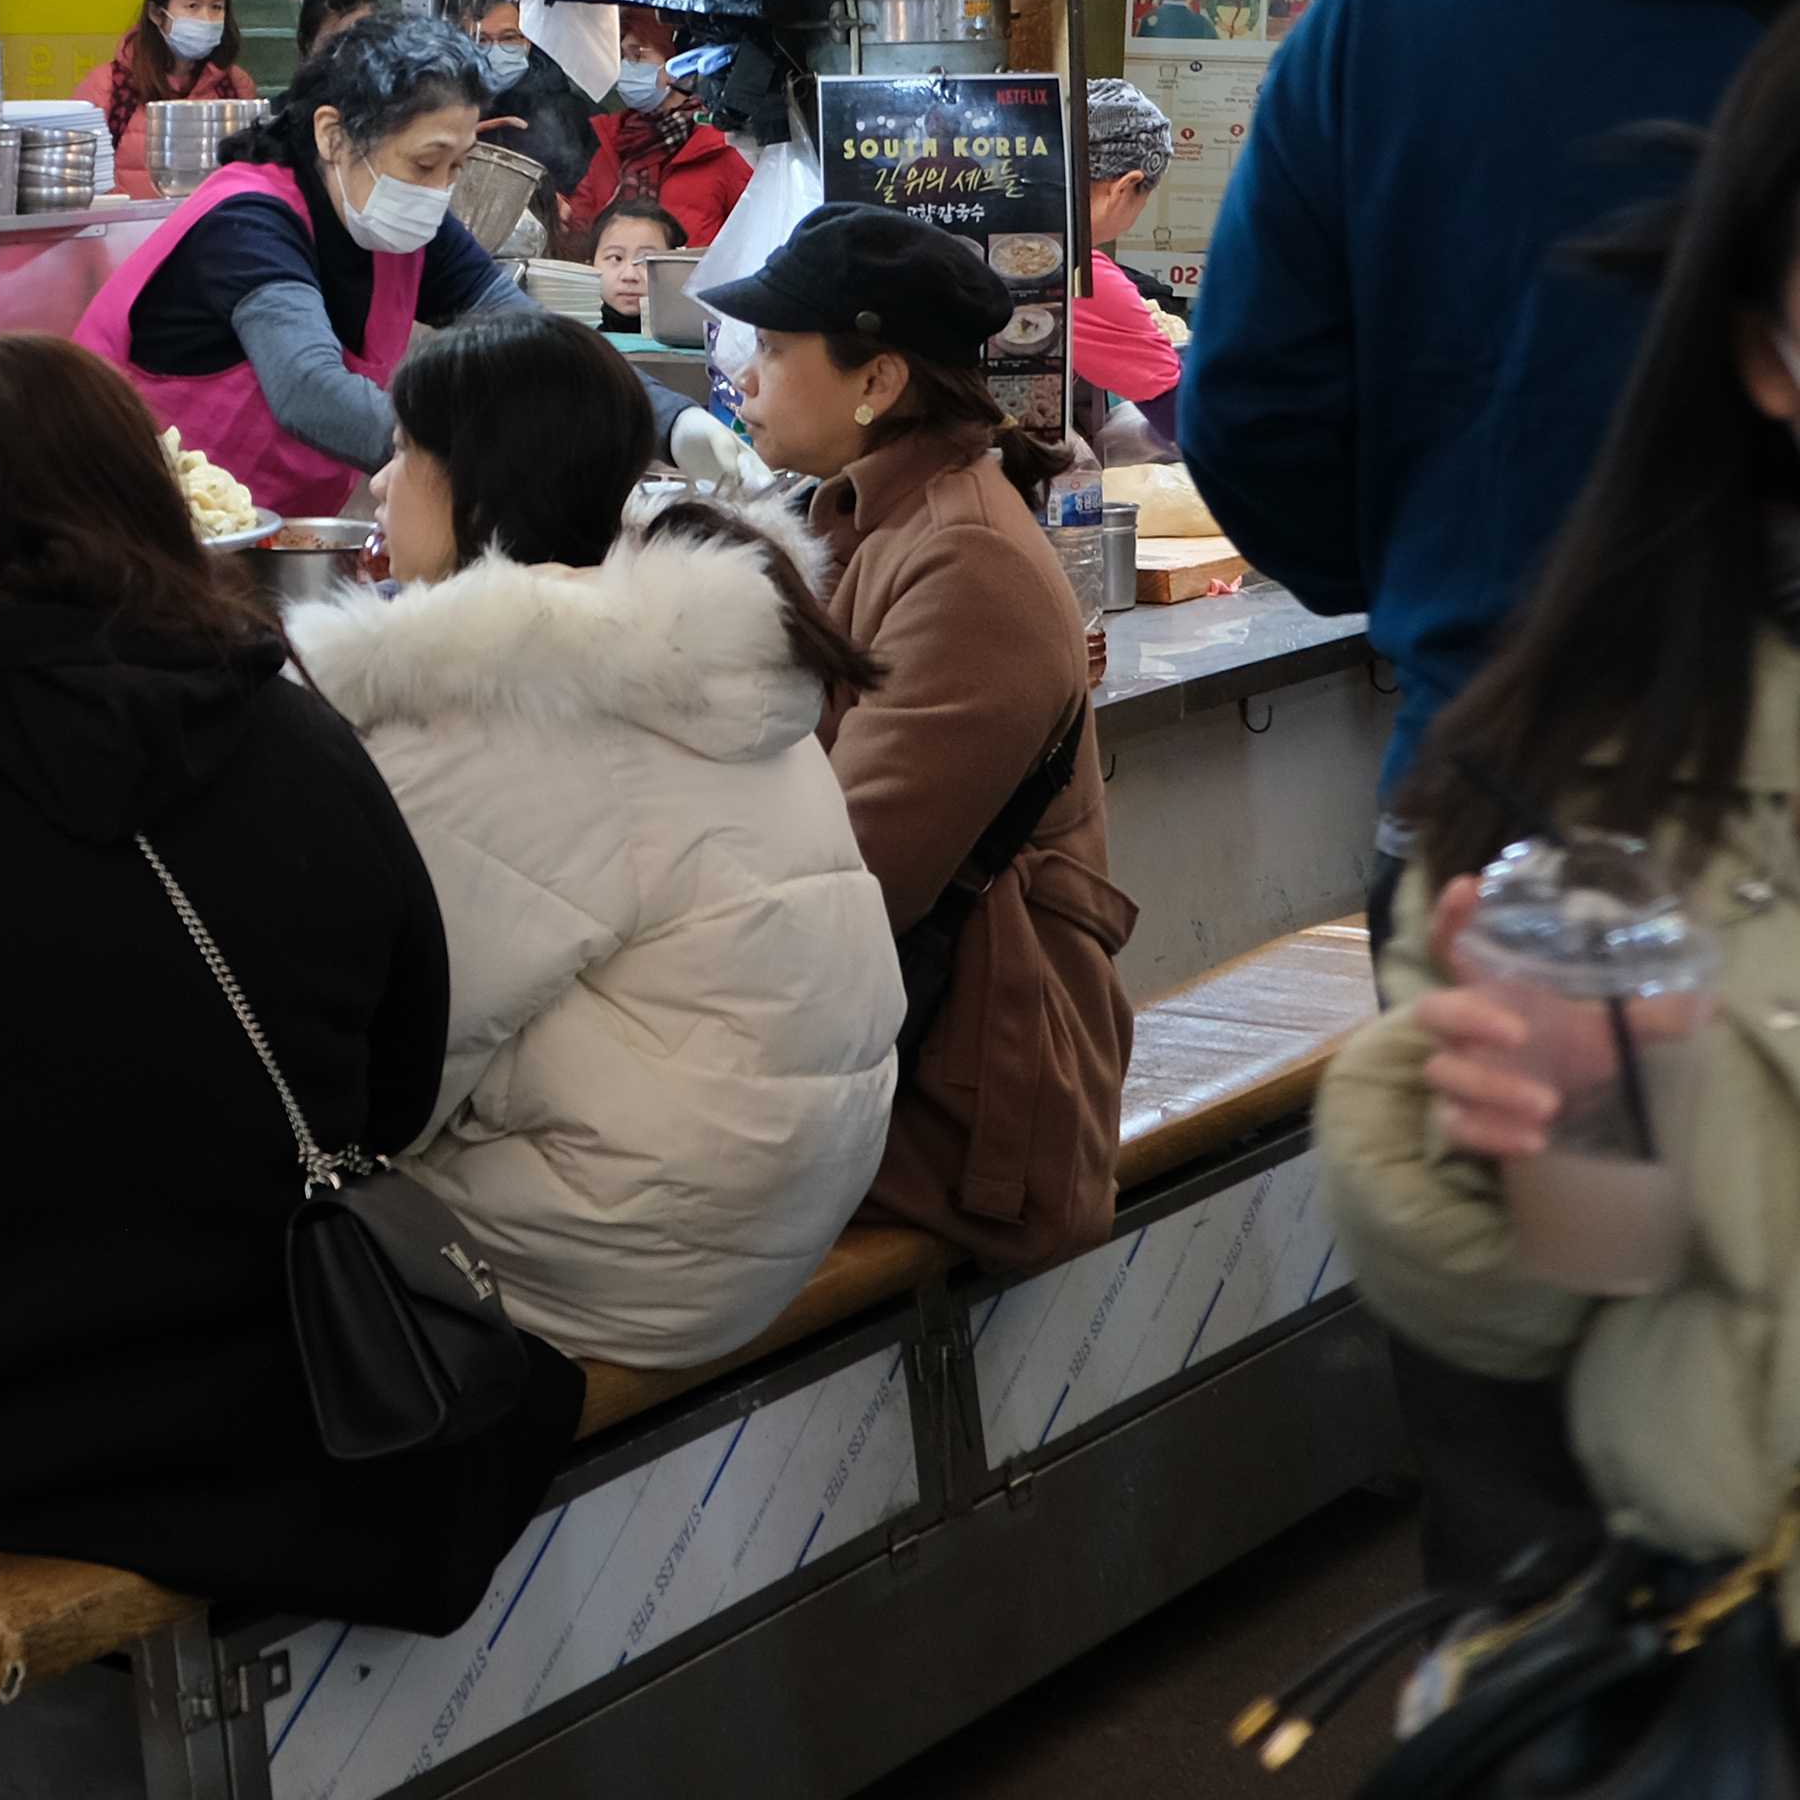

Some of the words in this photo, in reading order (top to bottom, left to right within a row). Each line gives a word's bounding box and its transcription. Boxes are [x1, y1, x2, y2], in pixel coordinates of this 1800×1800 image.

[996, 89, 1048, 106] NETFLIX
[843, 138, 939, 160] SOUTH
[953, 136, 1048, 158] KOREA
[873, 162, 904, 204] 길
[903, 167, 948, 195] 위의
[1089, 1263, 1129, 1341] STAINLESS
[847, 1376, 892, 1464] STAINLESS
[823, 1457, 851, 1511] STEEL
[654, 1502, 701, 1596] STAINLESS
[623, 1594, 657, 1648] STEEL
[429, 1646, 489, 1749] STAINLESS
